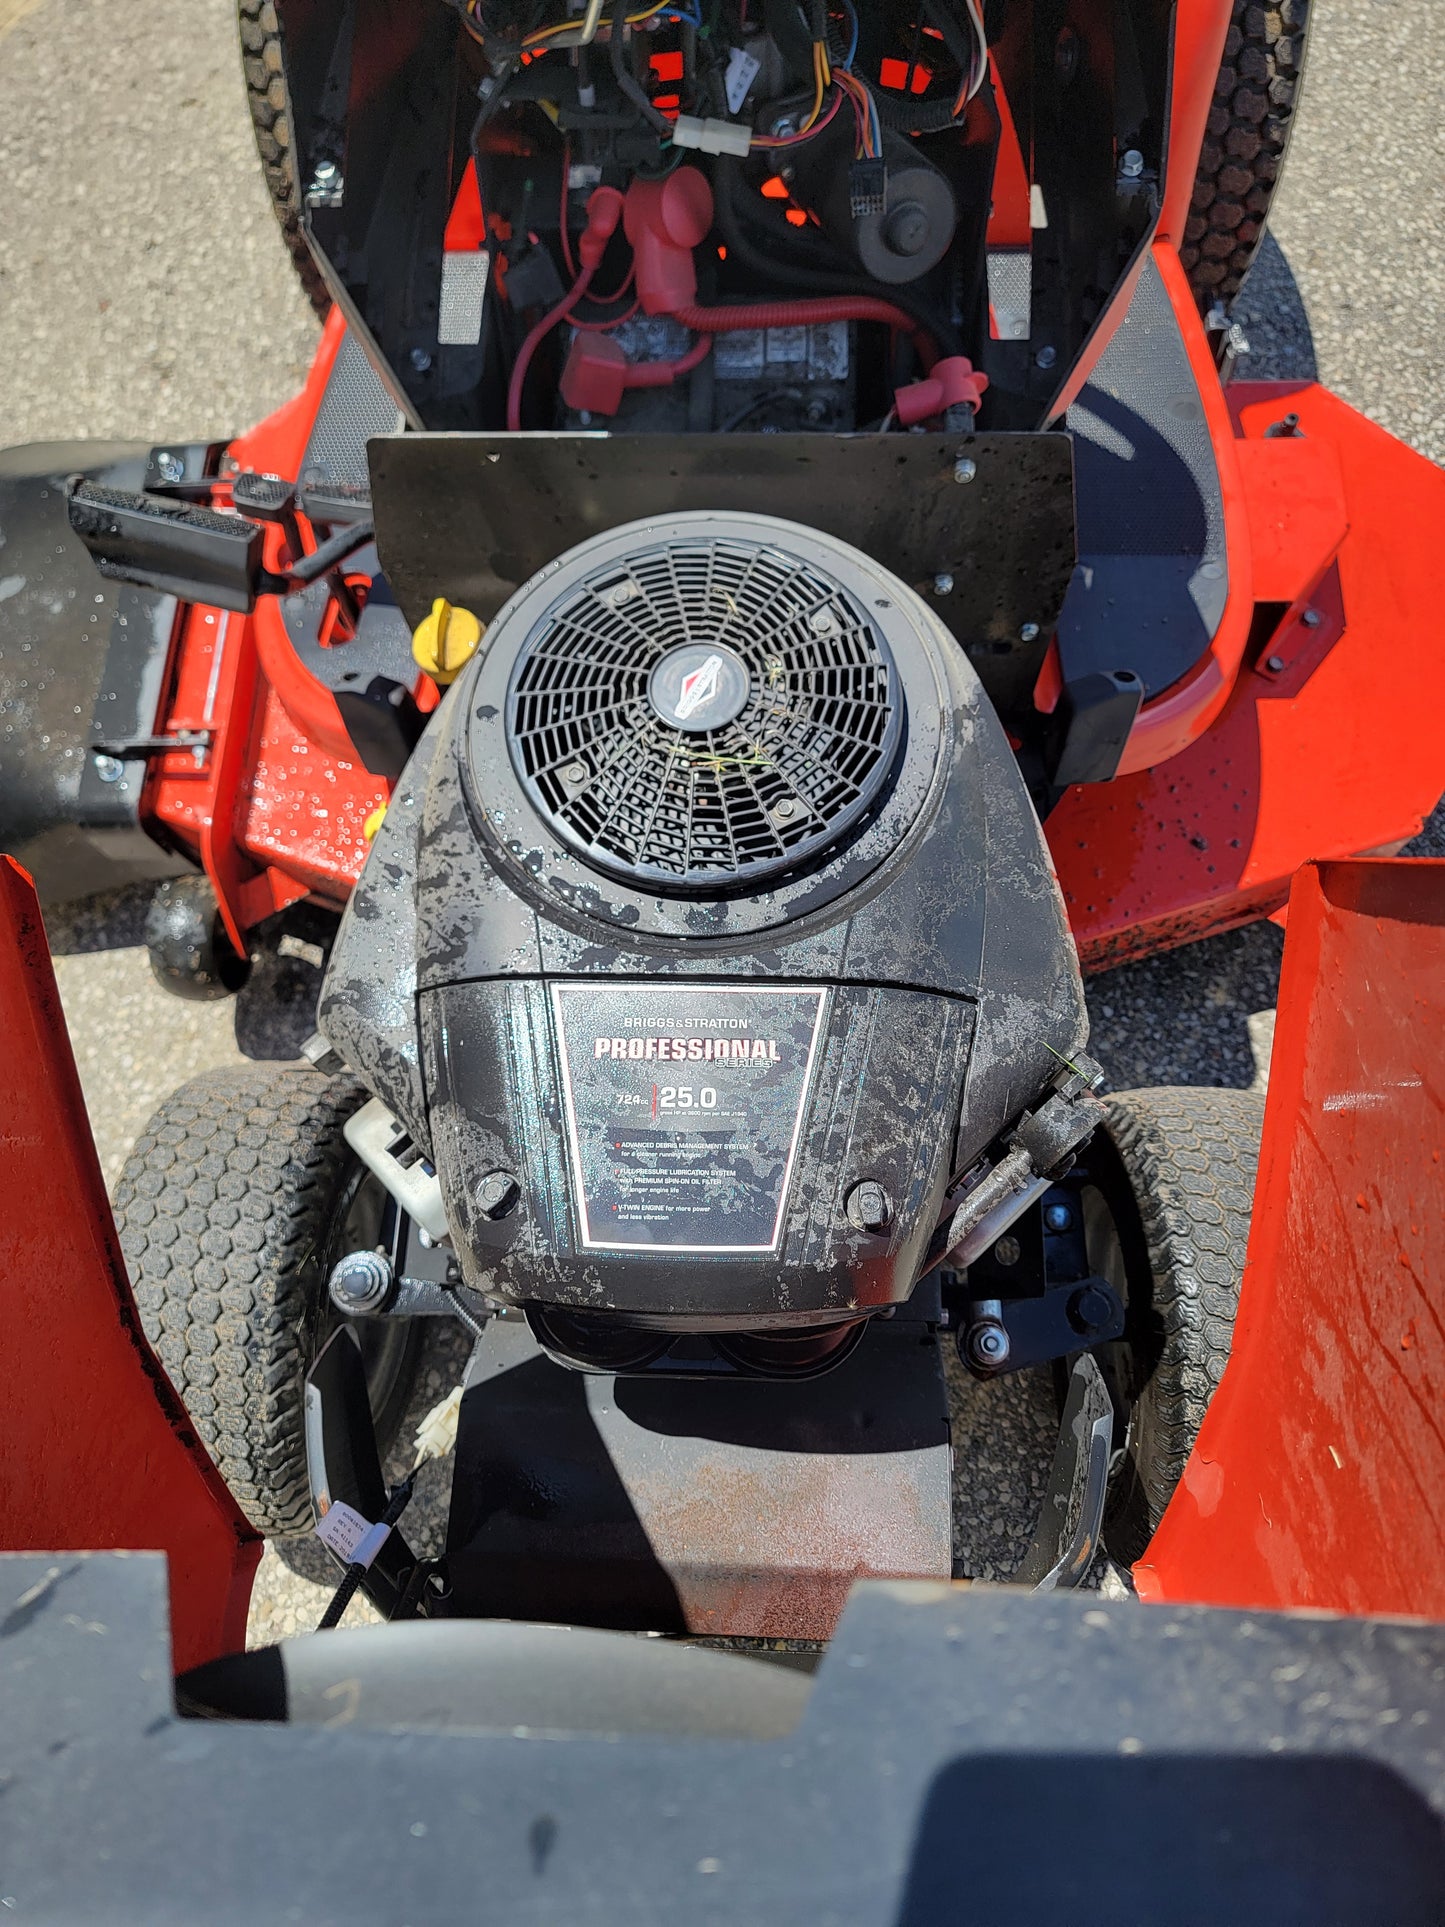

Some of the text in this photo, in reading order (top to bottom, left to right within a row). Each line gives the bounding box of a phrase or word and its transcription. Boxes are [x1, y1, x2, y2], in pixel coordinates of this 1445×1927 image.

[594, 1037, 781, 1061] PROFESSIONAL
[714, 1057, 774, 1068] SERIES
[660, 1086, 717, 1109] 25.0
[669, 1168, 710, 1176] LUBRICATION
[617, 1204, 640, 1212] V-TWIN
